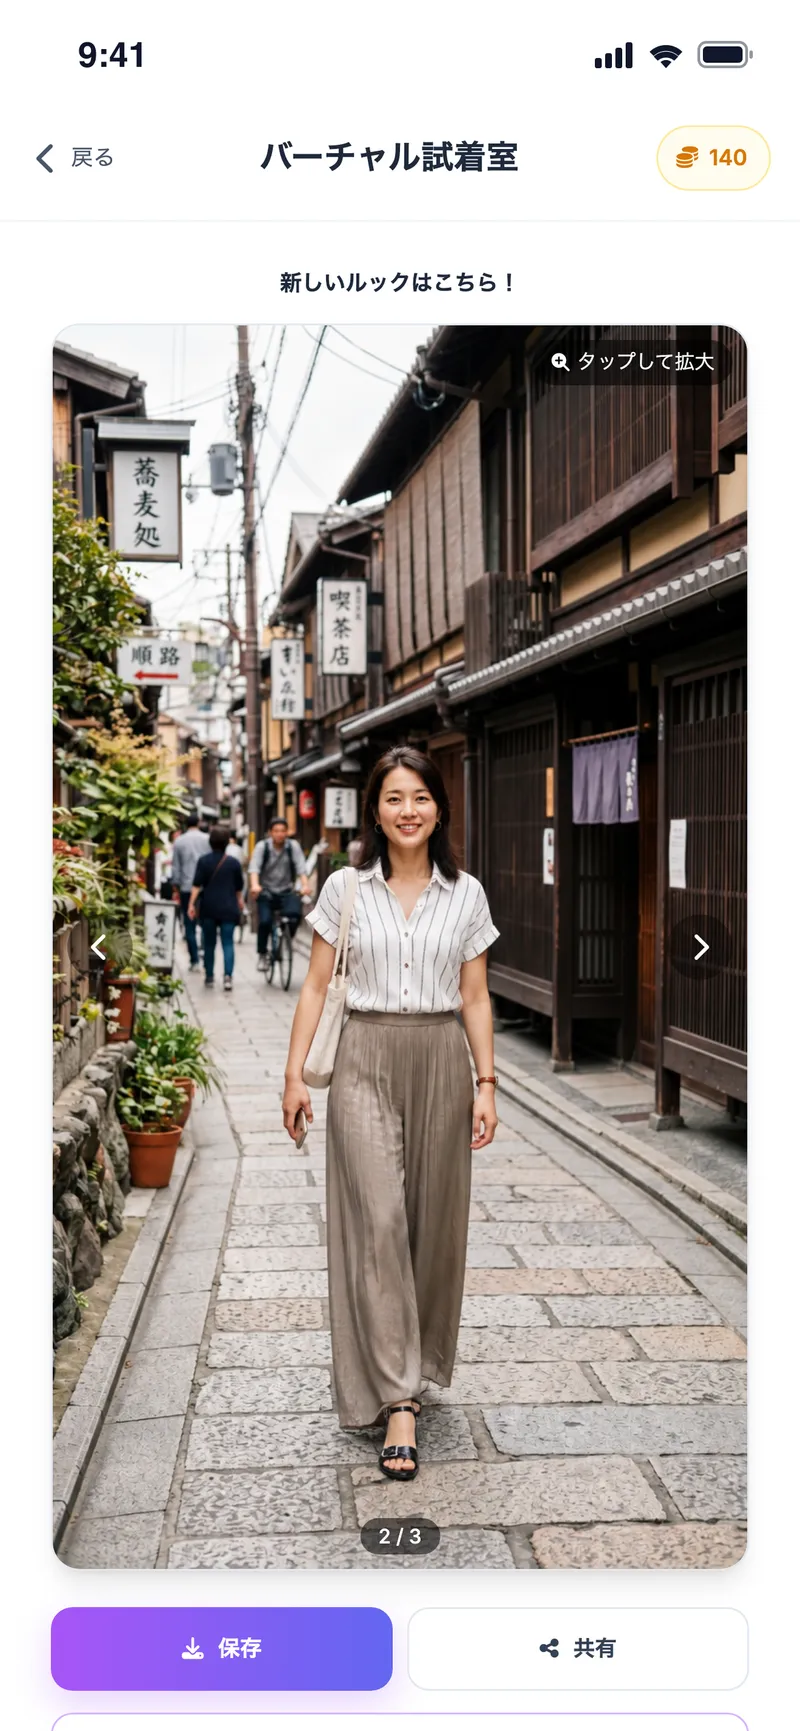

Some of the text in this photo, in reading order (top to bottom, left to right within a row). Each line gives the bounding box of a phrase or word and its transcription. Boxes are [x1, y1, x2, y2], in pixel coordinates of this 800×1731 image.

[78, 41, 144, 69] 9:41
[71, 147, 114, 168] 戻る
[260, 140, 519, 173] バーチャル試着室
[709, 148, 747, 167] 140
[279, 271, 513, 294] 新しいルックはこちら！
[133, 456, 161, 548] 蕎麦処
[330, 589, 351, 666] 喫茶店
[131, 644, 180, 666] 順路
[217, 1636, 262, 1660] 保存
[573, 1636, 617, 1660] 共有
